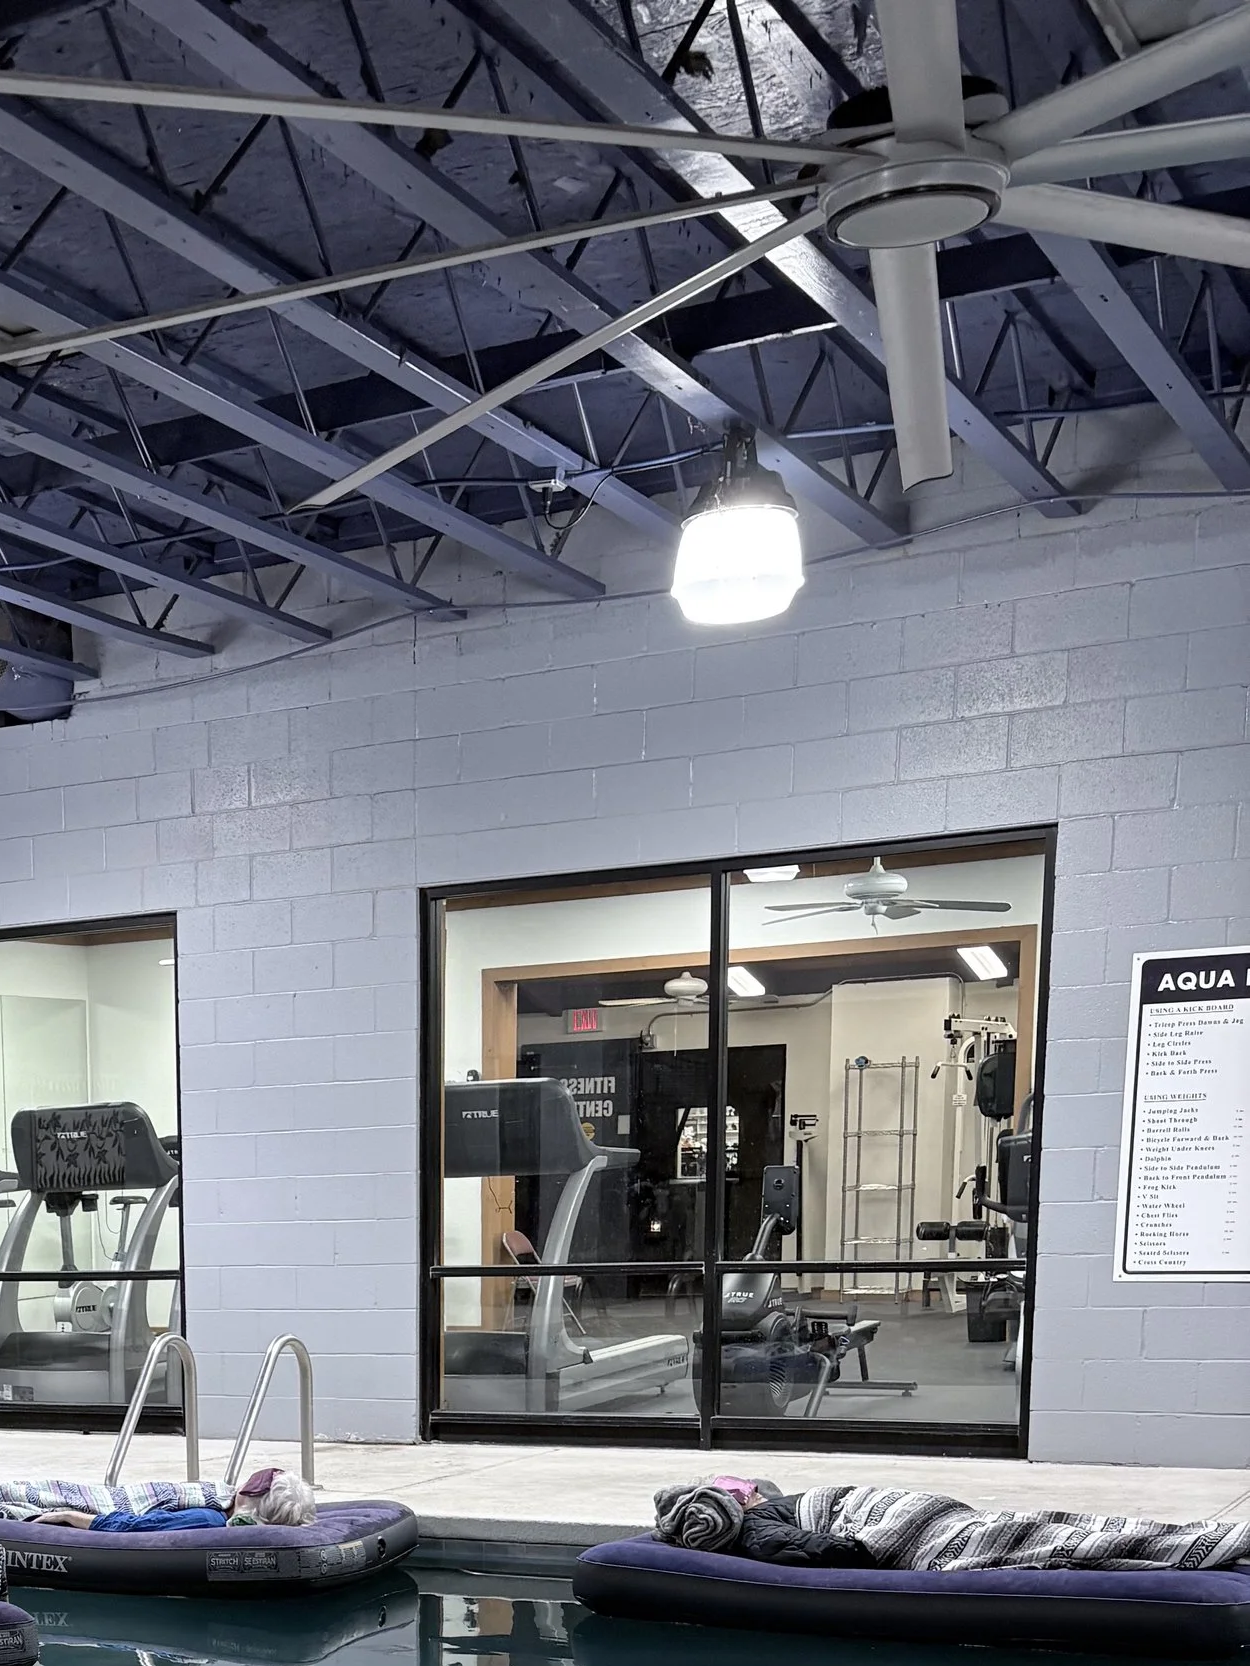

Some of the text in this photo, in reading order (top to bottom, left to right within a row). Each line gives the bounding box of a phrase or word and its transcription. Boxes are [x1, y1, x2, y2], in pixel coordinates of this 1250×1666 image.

[1158, 970, 1235, 991] AQUA
[731, 1291, 754, 1299] TRUE
[6, 1549, 68, 1573] INTEX
